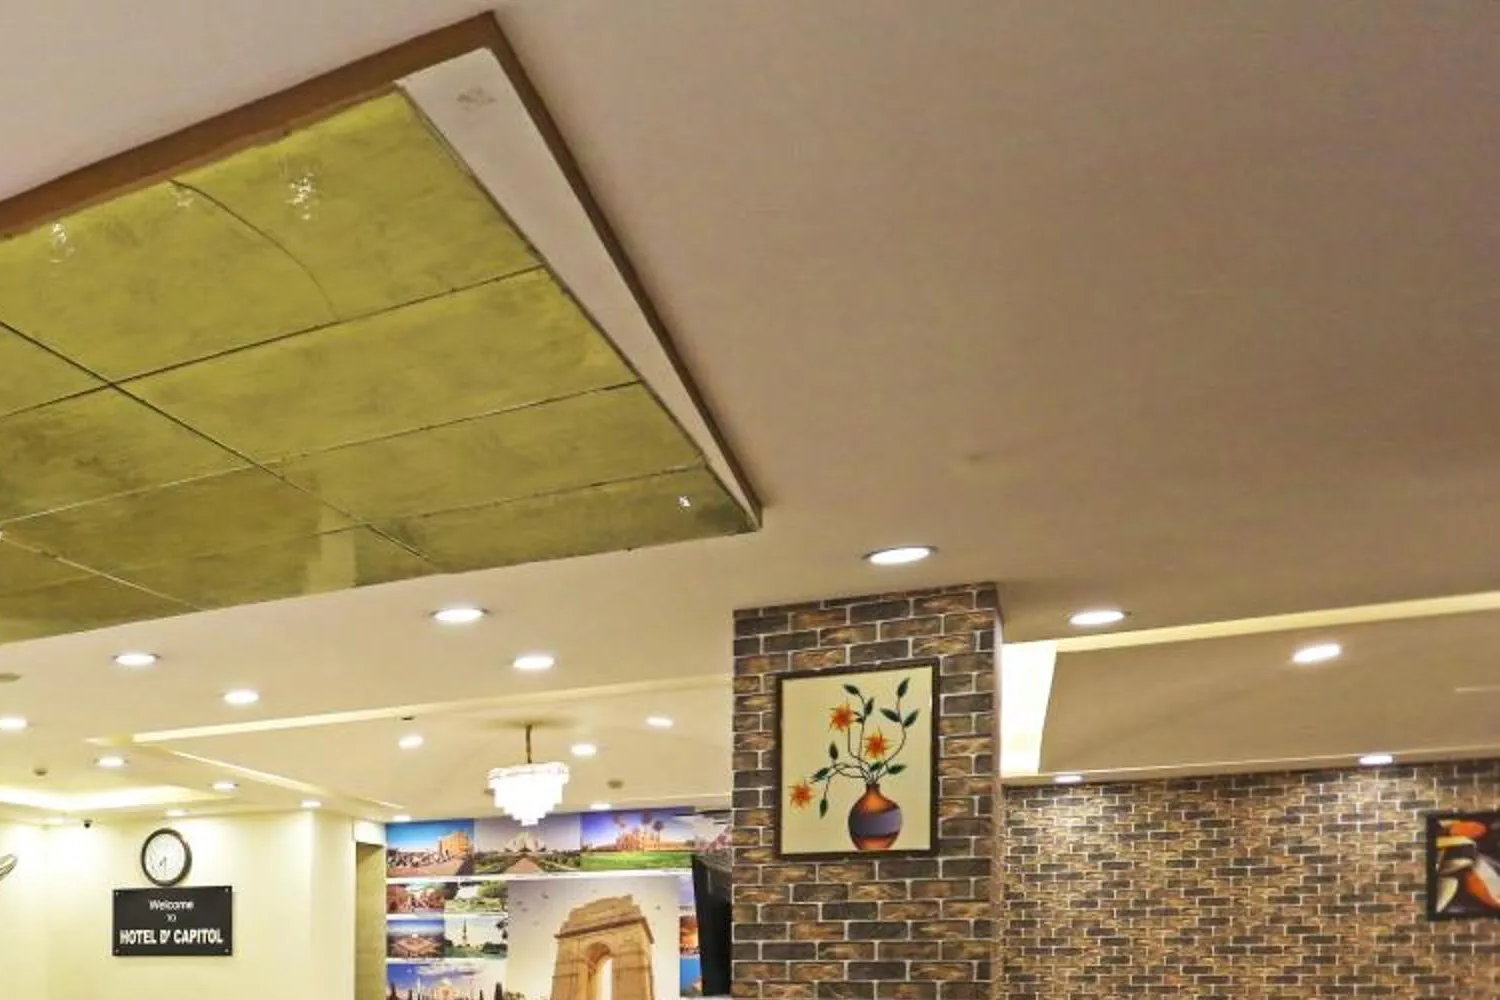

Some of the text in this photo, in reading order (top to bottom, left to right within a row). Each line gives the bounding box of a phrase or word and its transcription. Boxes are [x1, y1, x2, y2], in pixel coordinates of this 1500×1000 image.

[149, 900, 194, 910] Welcome
[119, 928, 224, 945] HOTEL D' CAPITOL
